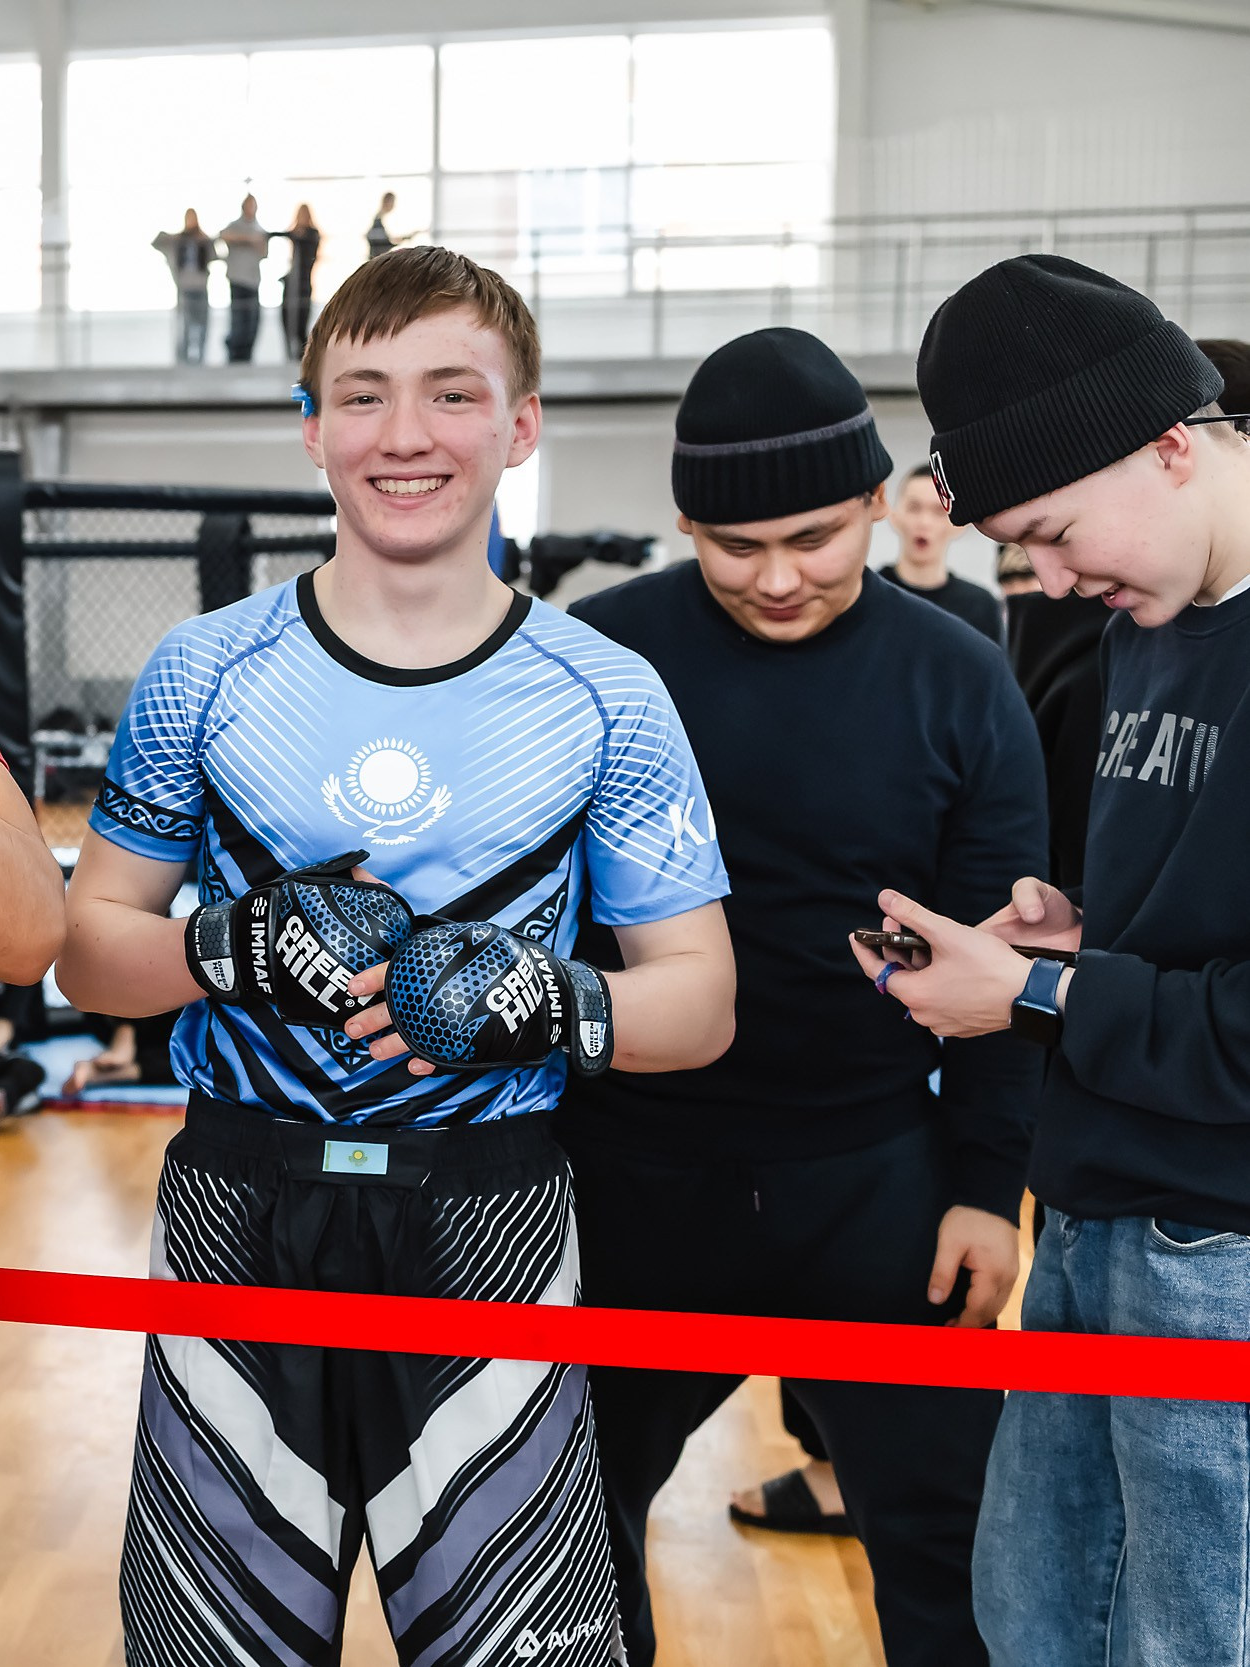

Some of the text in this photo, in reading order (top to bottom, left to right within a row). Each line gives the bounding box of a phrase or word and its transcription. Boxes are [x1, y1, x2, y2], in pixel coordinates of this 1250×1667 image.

[212, 962, 223, 986] HILL
[217, 960, 230, 989] GREEN
[251, 922, 273, 994] IMMAF
[275, 930, 340, 1013] HILL
[530, 947, 563, 1018] IMMAF
